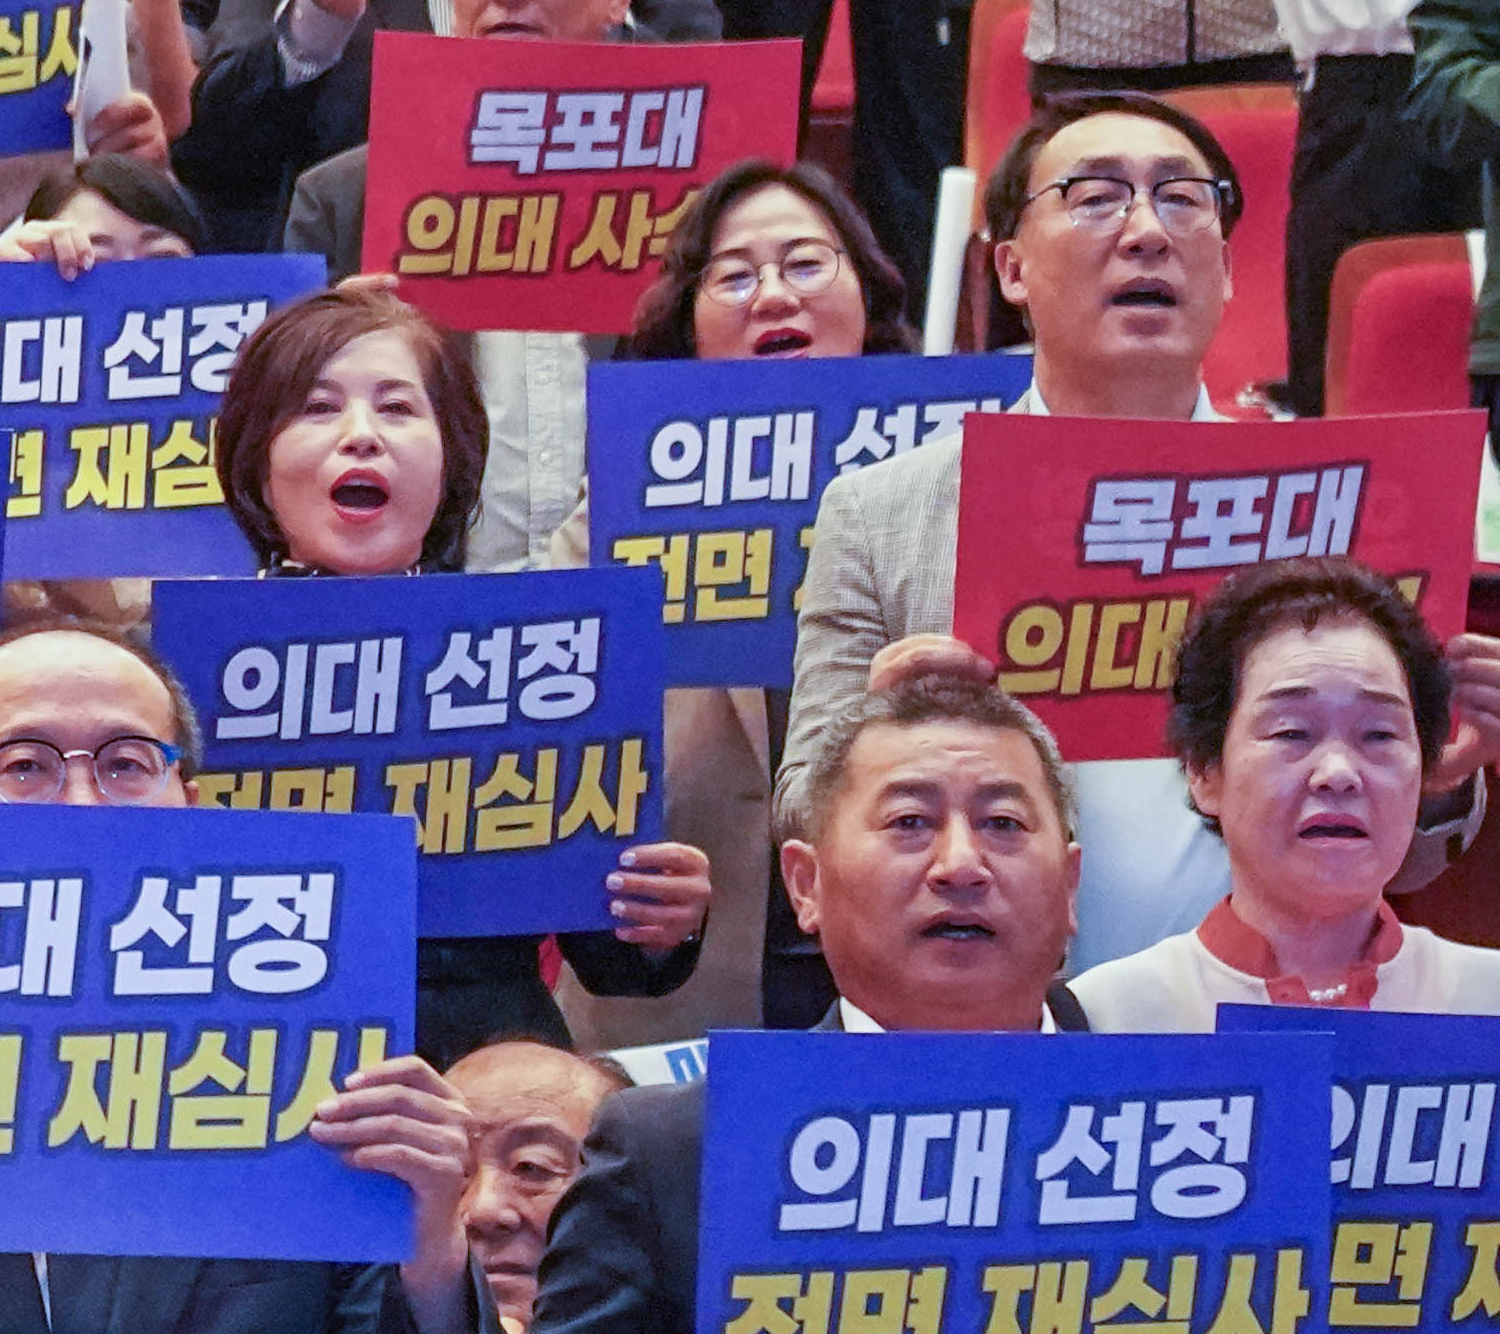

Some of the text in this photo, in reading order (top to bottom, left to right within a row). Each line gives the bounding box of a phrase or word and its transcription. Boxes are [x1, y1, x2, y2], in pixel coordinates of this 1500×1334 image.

[471, 89, 703, 173] 목포대
[399, 196, 558, 274] 의대
[646, 413, 813, 506] 의대
[1084, 467, 1363, 574] 목포대
[217, 618, 600, 739] 의대 선정
[390, 742, 645, 851] 재심사
[110, 874, 334, 994] 선정
[779, 1096, 1254, 1232] 의대 선정
